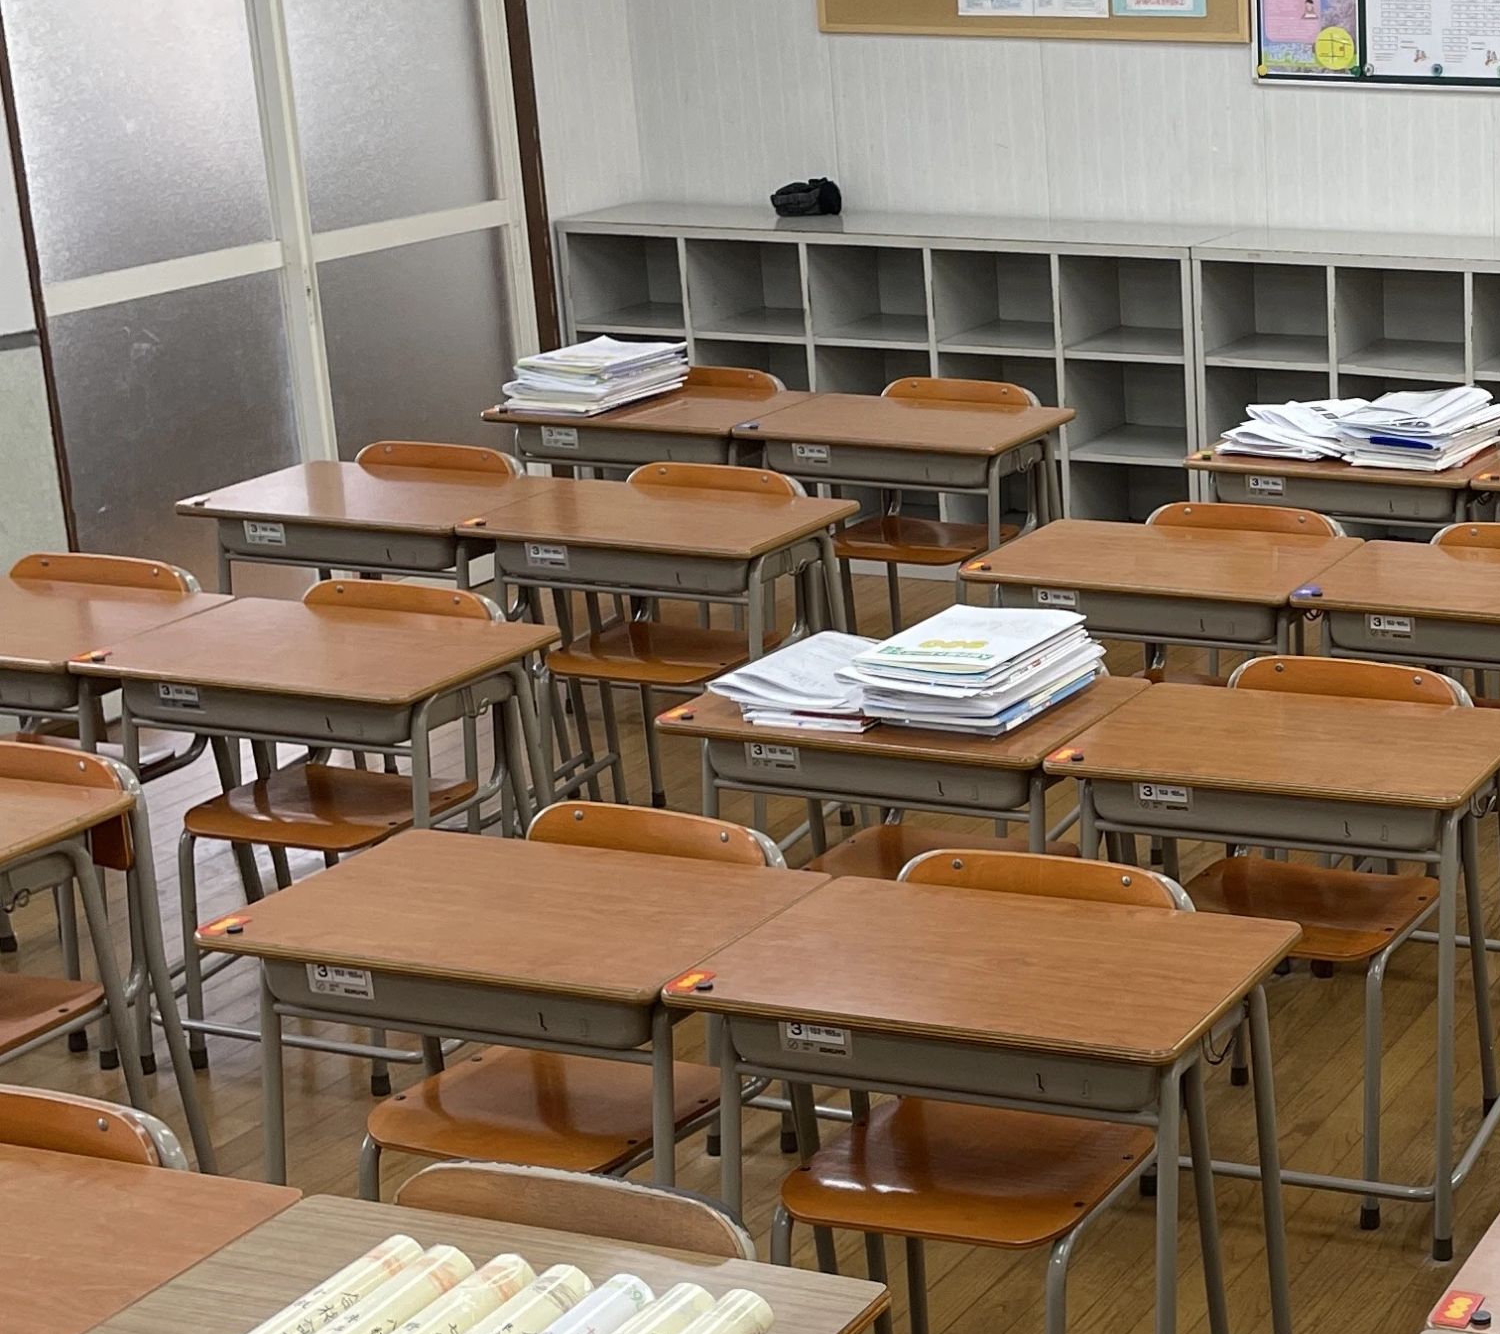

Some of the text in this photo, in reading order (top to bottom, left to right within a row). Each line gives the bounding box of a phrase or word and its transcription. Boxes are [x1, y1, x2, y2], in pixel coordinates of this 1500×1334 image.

[753, 745, 762, 755] 3
[1143, 786, 1152, 796] 3
[318, 964, 328, 977] 3
[791, 1023, 802, 1035] 3
